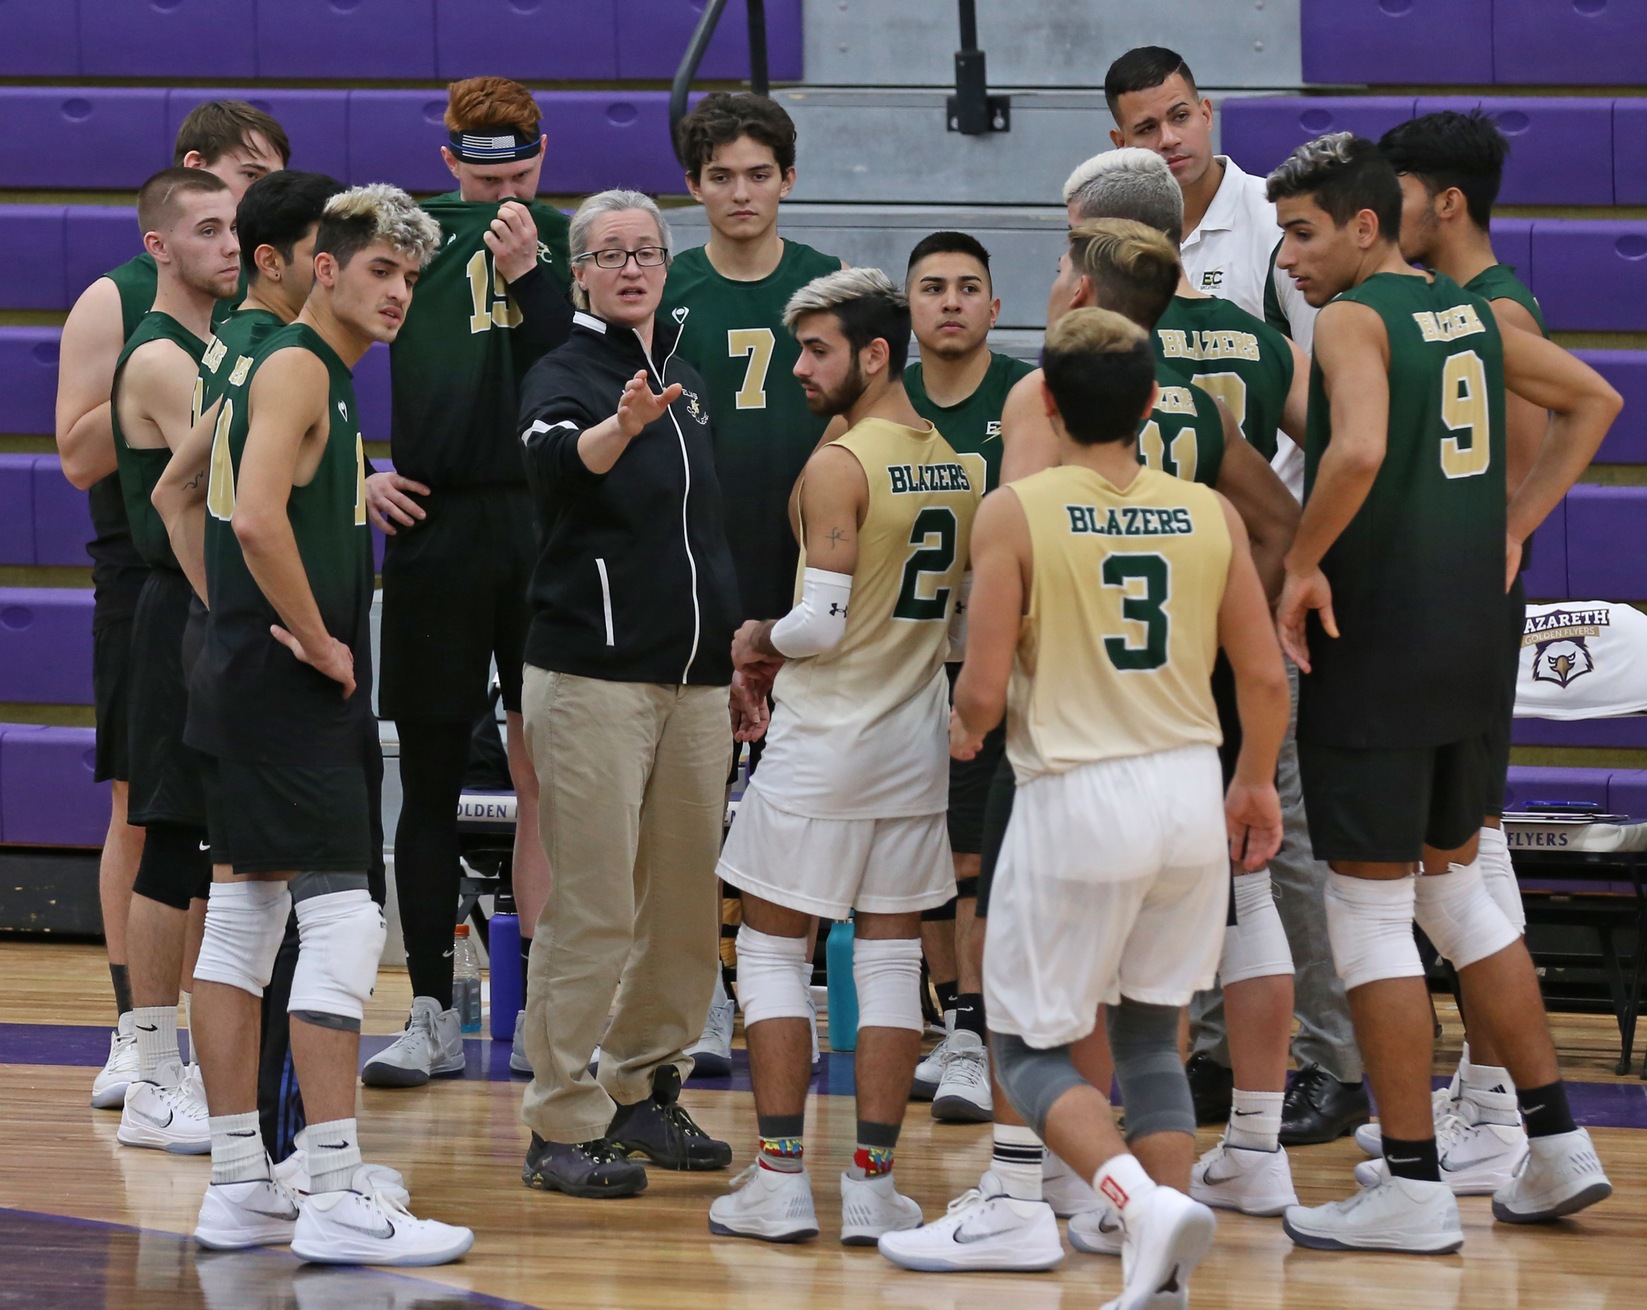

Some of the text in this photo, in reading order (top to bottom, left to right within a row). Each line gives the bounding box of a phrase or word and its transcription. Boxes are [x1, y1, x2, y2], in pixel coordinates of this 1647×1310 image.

[1202, 271, 1224, 285] EC
[1157, 329, 1260, 361] BLAZERS
[727, 327, 776, 410] 7
[1440, 349, 1490, 479] 9
[1139, 419, 1198, 483] 11
[887, 463, 970, 494] BLAZERS
[1065, 504, 1195, 537] BLAZERS
[892, 506, 957, 621] 2
[1101, 552, 1173, 672] 3
[1525, 626, 1596, 645] GOLDEN FLYERS
[1507, 832, 1568, 846] FLYERS
